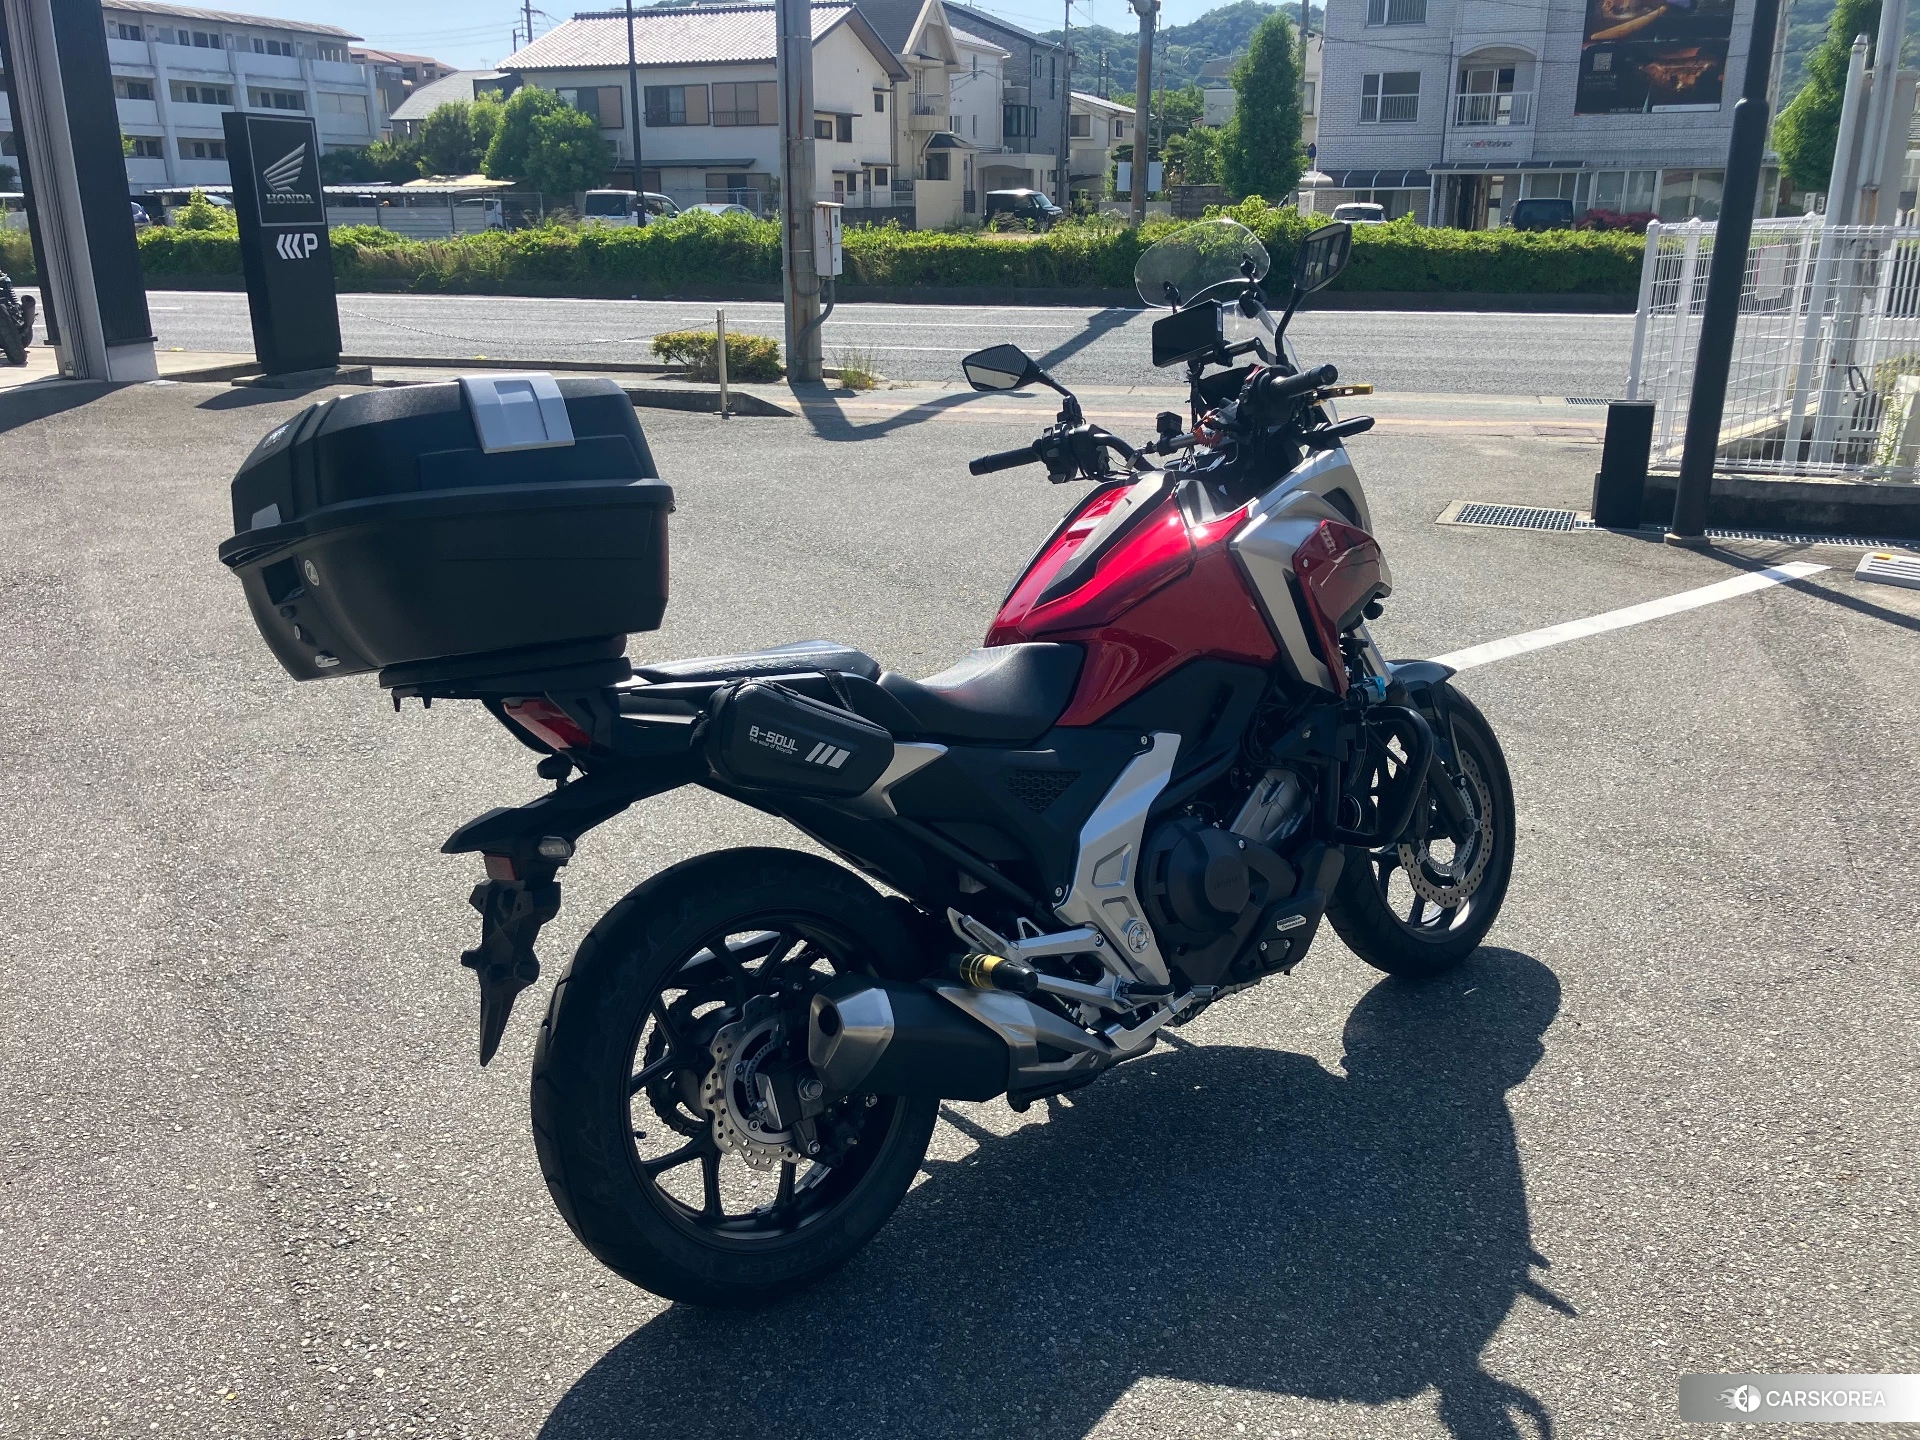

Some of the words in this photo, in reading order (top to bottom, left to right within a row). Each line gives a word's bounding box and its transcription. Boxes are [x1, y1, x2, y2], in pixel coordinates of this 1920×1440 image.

[266, 193, 315, 204] HONDA
[303, 233, 318, 258] P
[749, 725, 798, 751] B-SOUL
